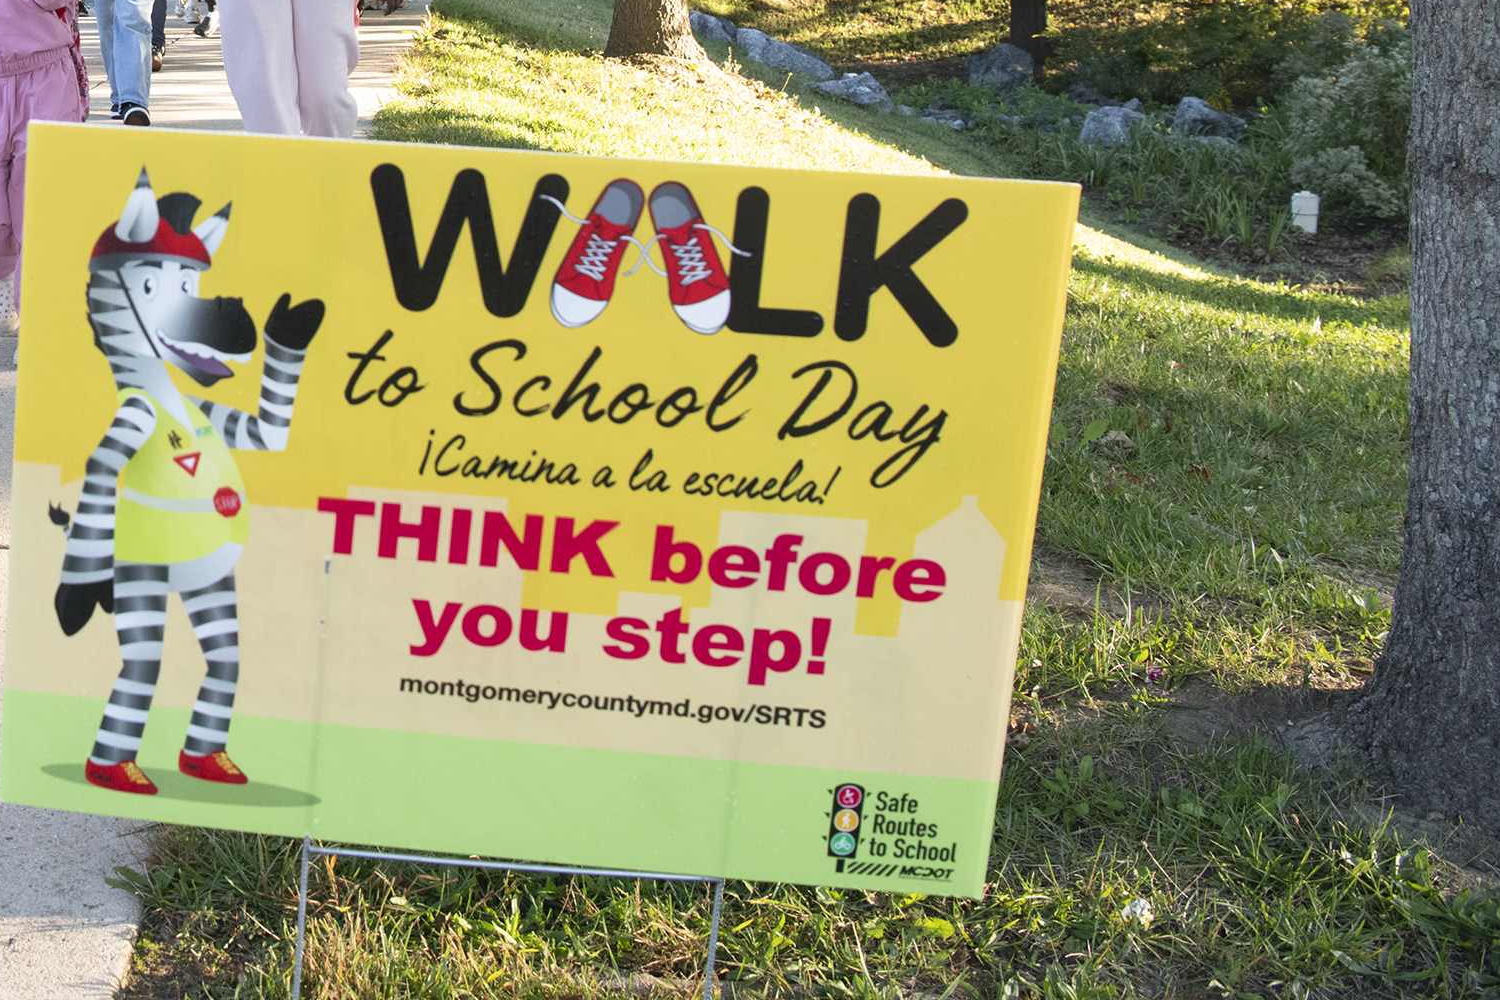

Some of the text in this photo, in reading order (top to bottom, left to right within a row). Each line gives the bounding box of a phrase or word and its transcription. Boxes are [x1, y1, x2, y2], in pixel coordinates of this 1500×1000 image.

[344, 329, 949, 489] to School Day
[418, 429, 842, 505] ¡Camina a la escuela!
[317, 497, 947, 603] THINK before
[409, 597, 832, 686] you step!
[399, 676, 827, 729] montgomerycountymd.gov/SRTS
[872, 813, 939, 838] Routes
[875, 791, 919, 814] Safe
[869, 837, 957, 863] to School
[899, 865, 954, 879] MCDOT
